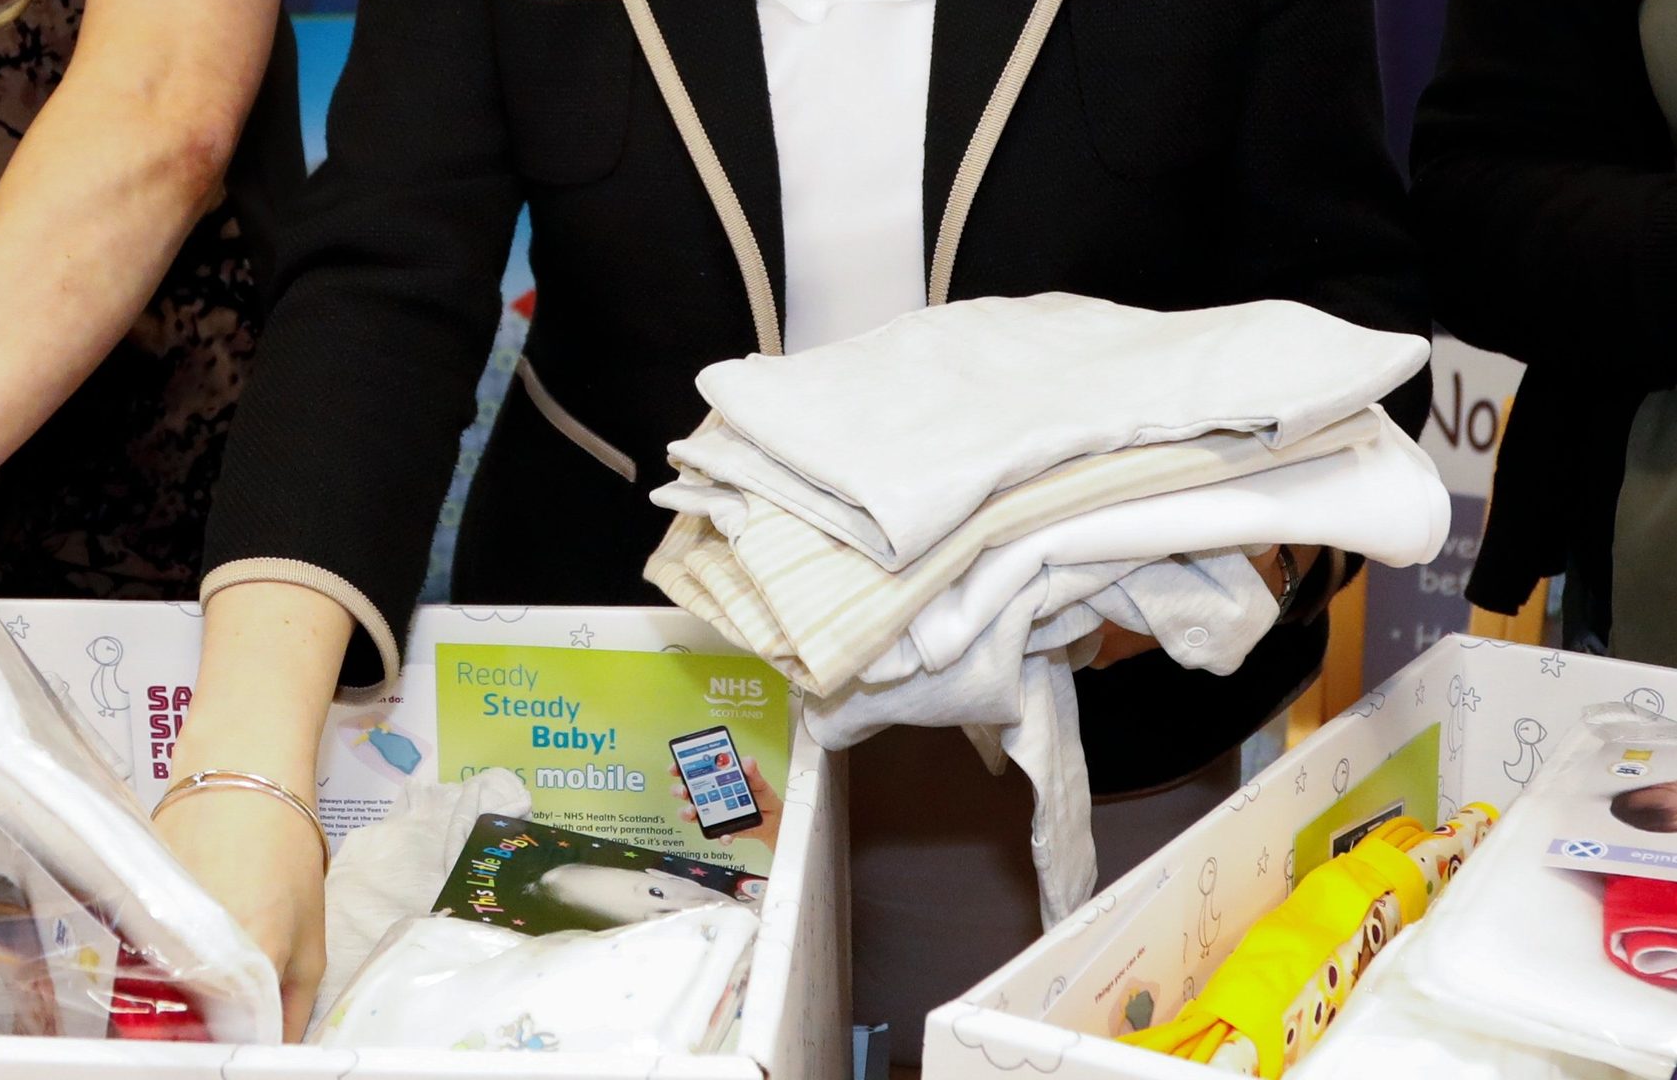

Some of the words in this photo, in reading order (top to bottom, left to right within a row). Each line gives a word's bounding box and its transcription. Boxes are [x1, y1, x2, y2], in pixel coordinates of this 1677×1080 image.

[457, 662, 539, 691] Ready
[709, 677, 763, 697] NHS
[147, 686, 193, 711] SA
[388, 695, 404, 704] do:
[483, 693, 580, 724] Steady
[709, 708, 764, 719] SCOTLAND
[532, 725, 616, 755] Baby!
[536, 763, 645, 792] mobile
[531, 810, 553, 820] aby!
[563, 812, 584, 820] NHS
[586, 813, 617, 822] Health
[618, 813, 665, 824] Scotland's
[576, 823, 594, 832] and
[595, 824, 618, 834] early
[620, 826, 673, 836] parenthood
[483, 833, 540, 860] Baby
[633, 837, 645, 845] So
[647, 838, 661, 846] it's
[662, 839, 685, 847] even
[666, 849, 701, 859] lanning
[465, 857, 502, 888] Little
[467, 889, 504, 913] This
